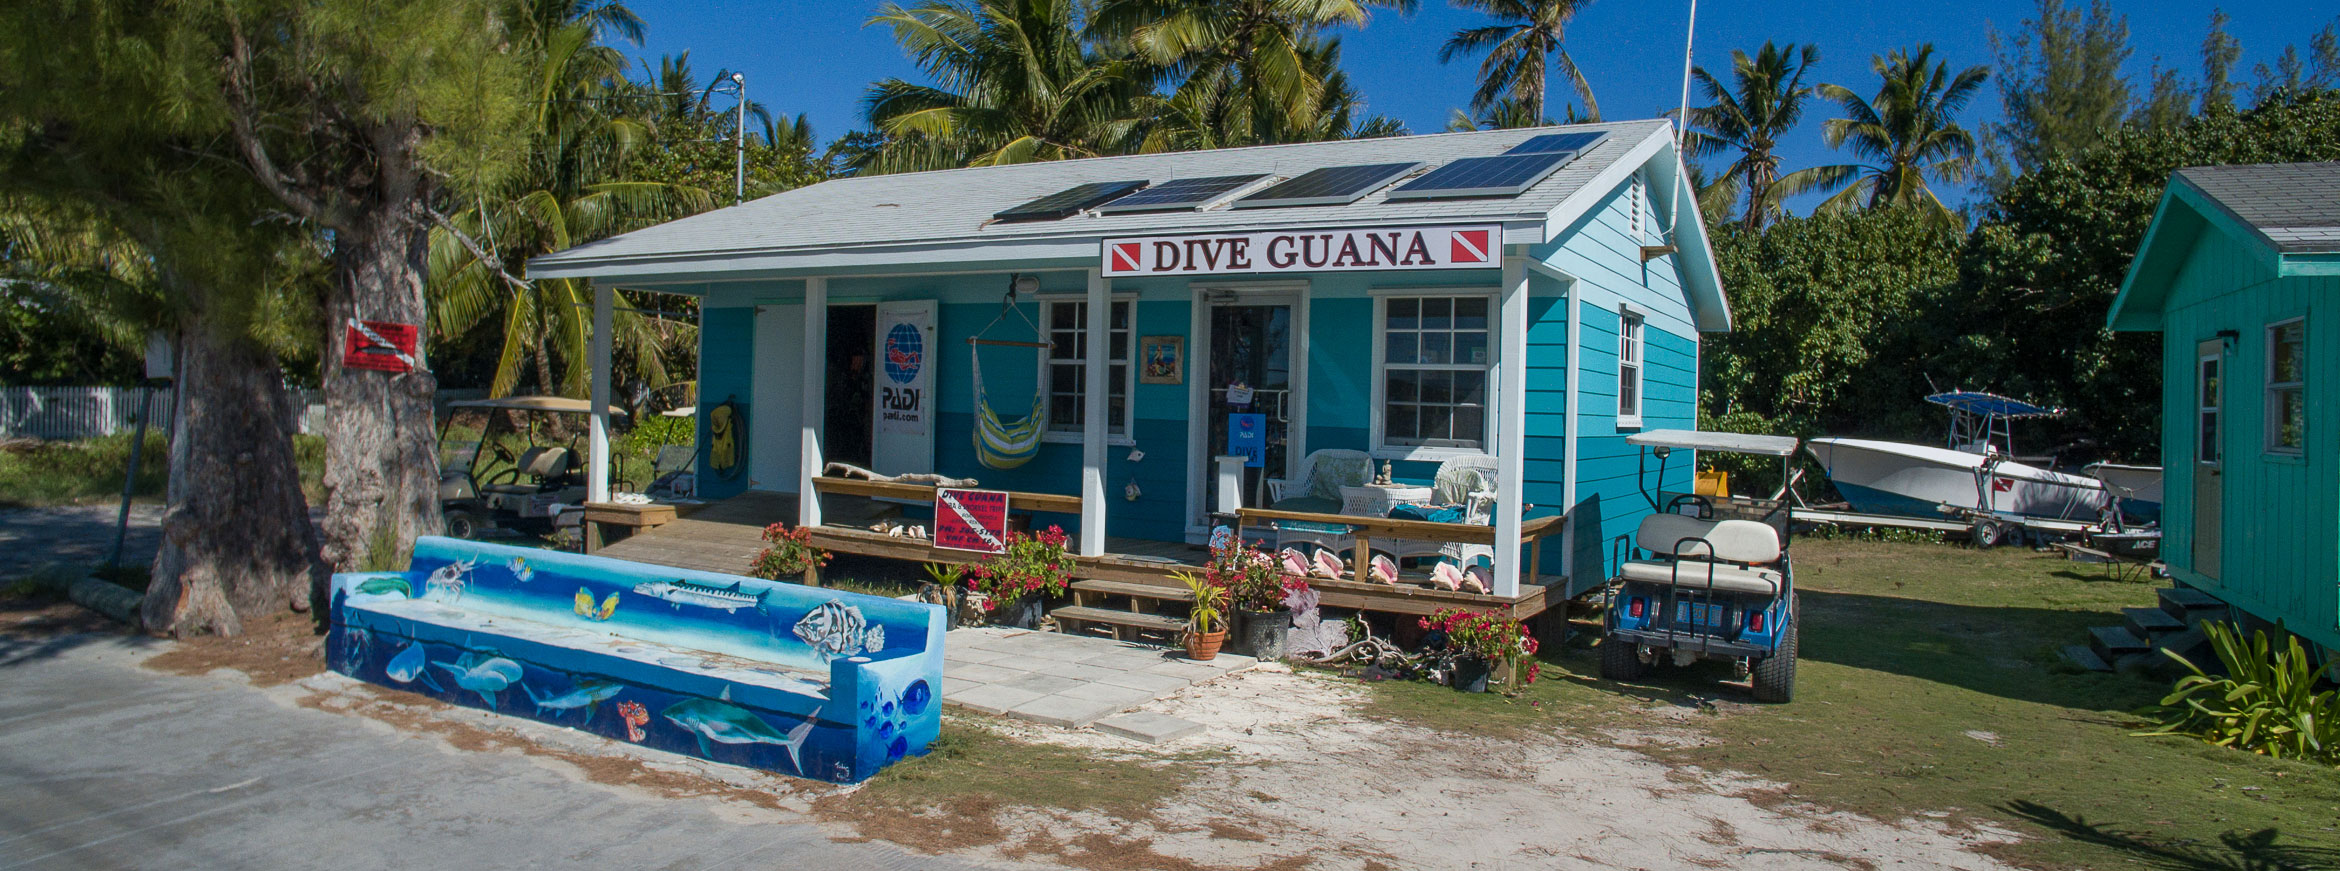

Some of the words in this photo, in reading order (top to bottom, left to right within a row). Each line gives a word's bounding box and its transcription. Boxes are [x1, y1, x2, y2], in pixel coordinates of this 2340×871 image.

[1152, 238, 1253, 272] DIVE
[1266, 231, 1436, 268] GUANA
[882, 386, 920, 411] PADI
[883, 411, 919, 422] padi.com
[1239, 431, 1254, 439] PADI
[1235, 446, 1258, 457] DIVE
[942, 490, 965, 500] DIVE
[968, 492, 1003, 502] GUANA
[2132, 540, 2157, 549] ACE
